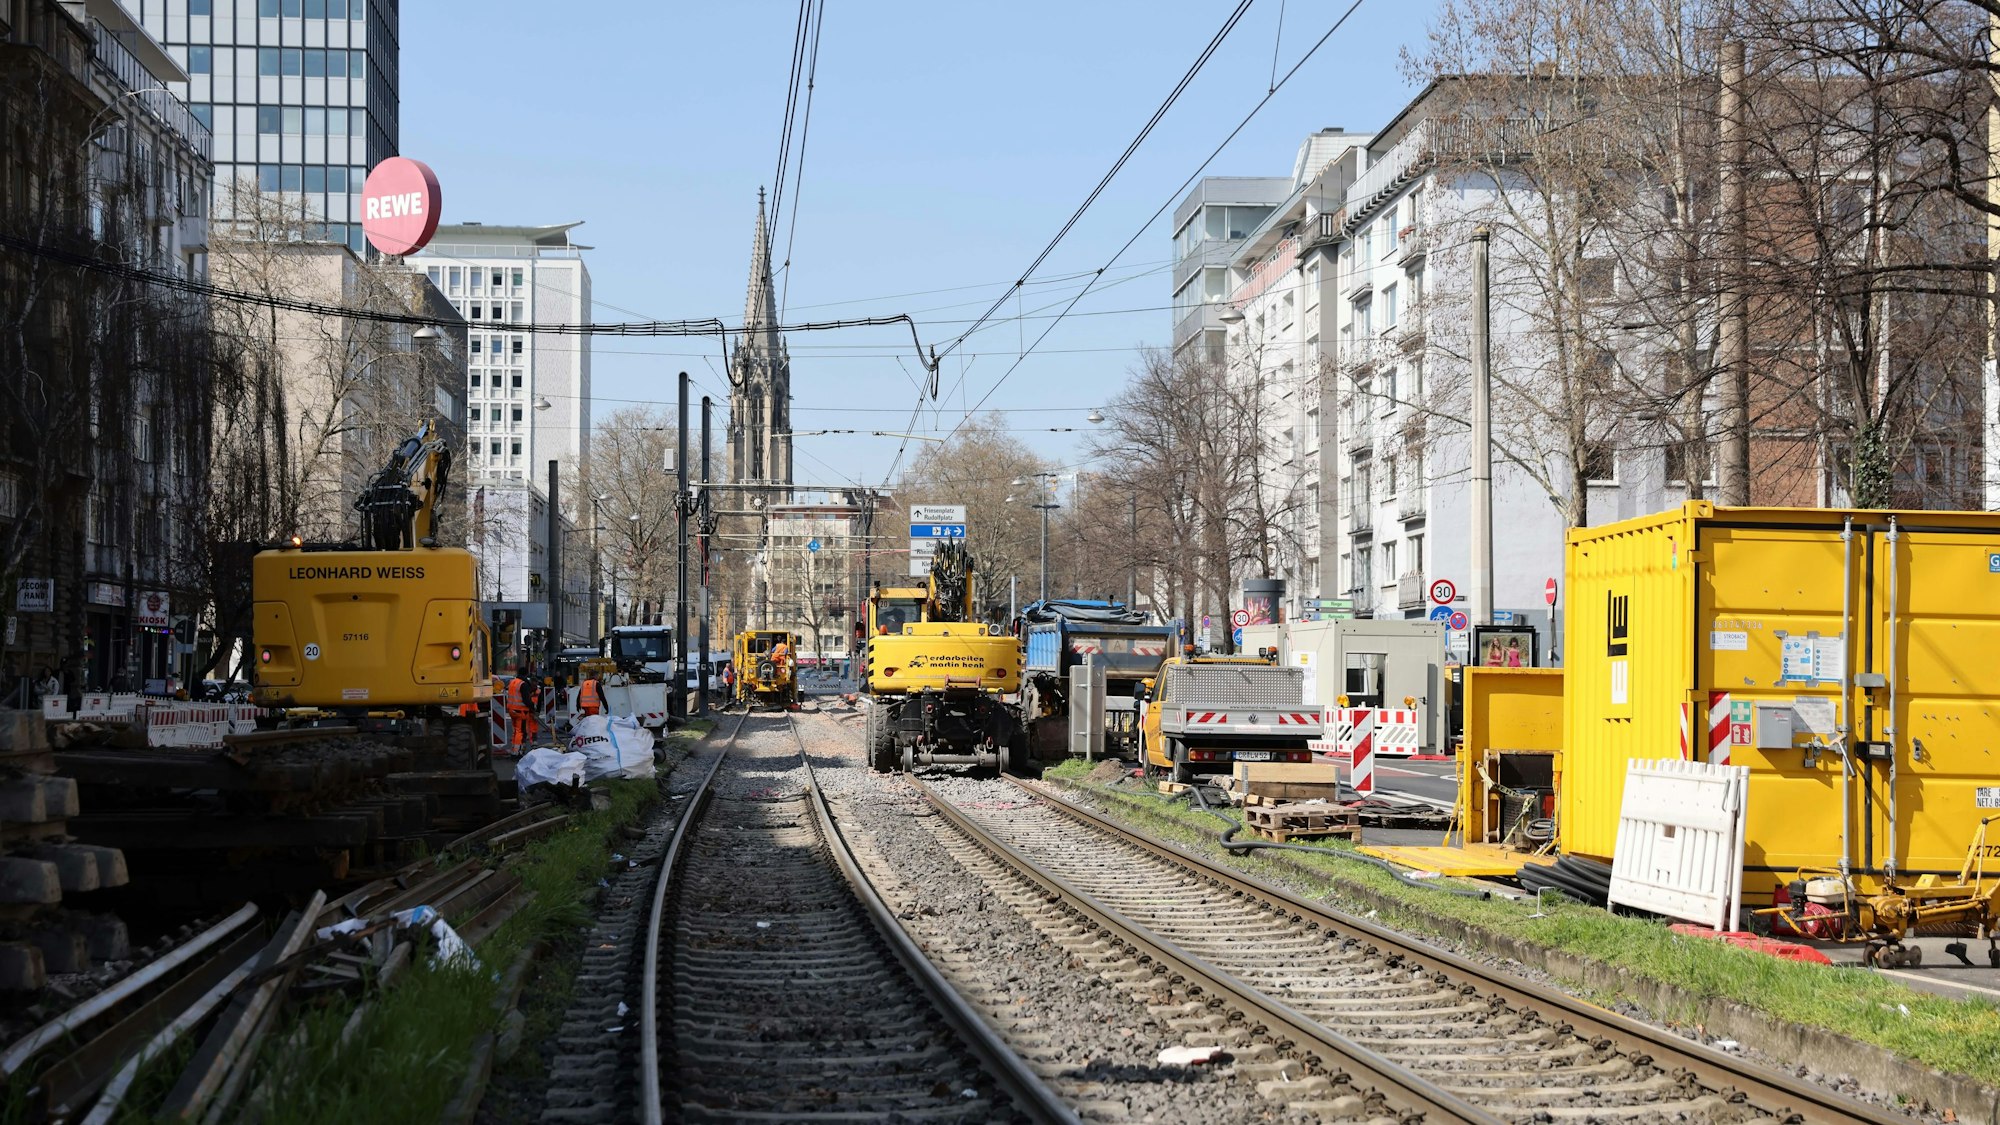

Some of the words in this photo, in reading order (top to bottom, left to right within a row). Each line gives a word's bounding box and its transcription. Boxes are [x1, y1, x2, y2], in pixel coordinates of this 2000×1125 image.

[366, 192, 423, 220] REWE
[289, 566, 372, 580] LEONHARD
[376, 566, 425, 579] WEISS
[21, 582, 49, 590] SECOND
[1435, 586, 1451, 598] 30
[879, 600, 888, 608] 20
[137, 616, 166, 625] KIOSK
[1236, 614, 1247, 623] 30
[343, 633, 369, 641] 57116
[305, 646, 319, 657] 20
[1977, 787, 1992, 797] TARE
